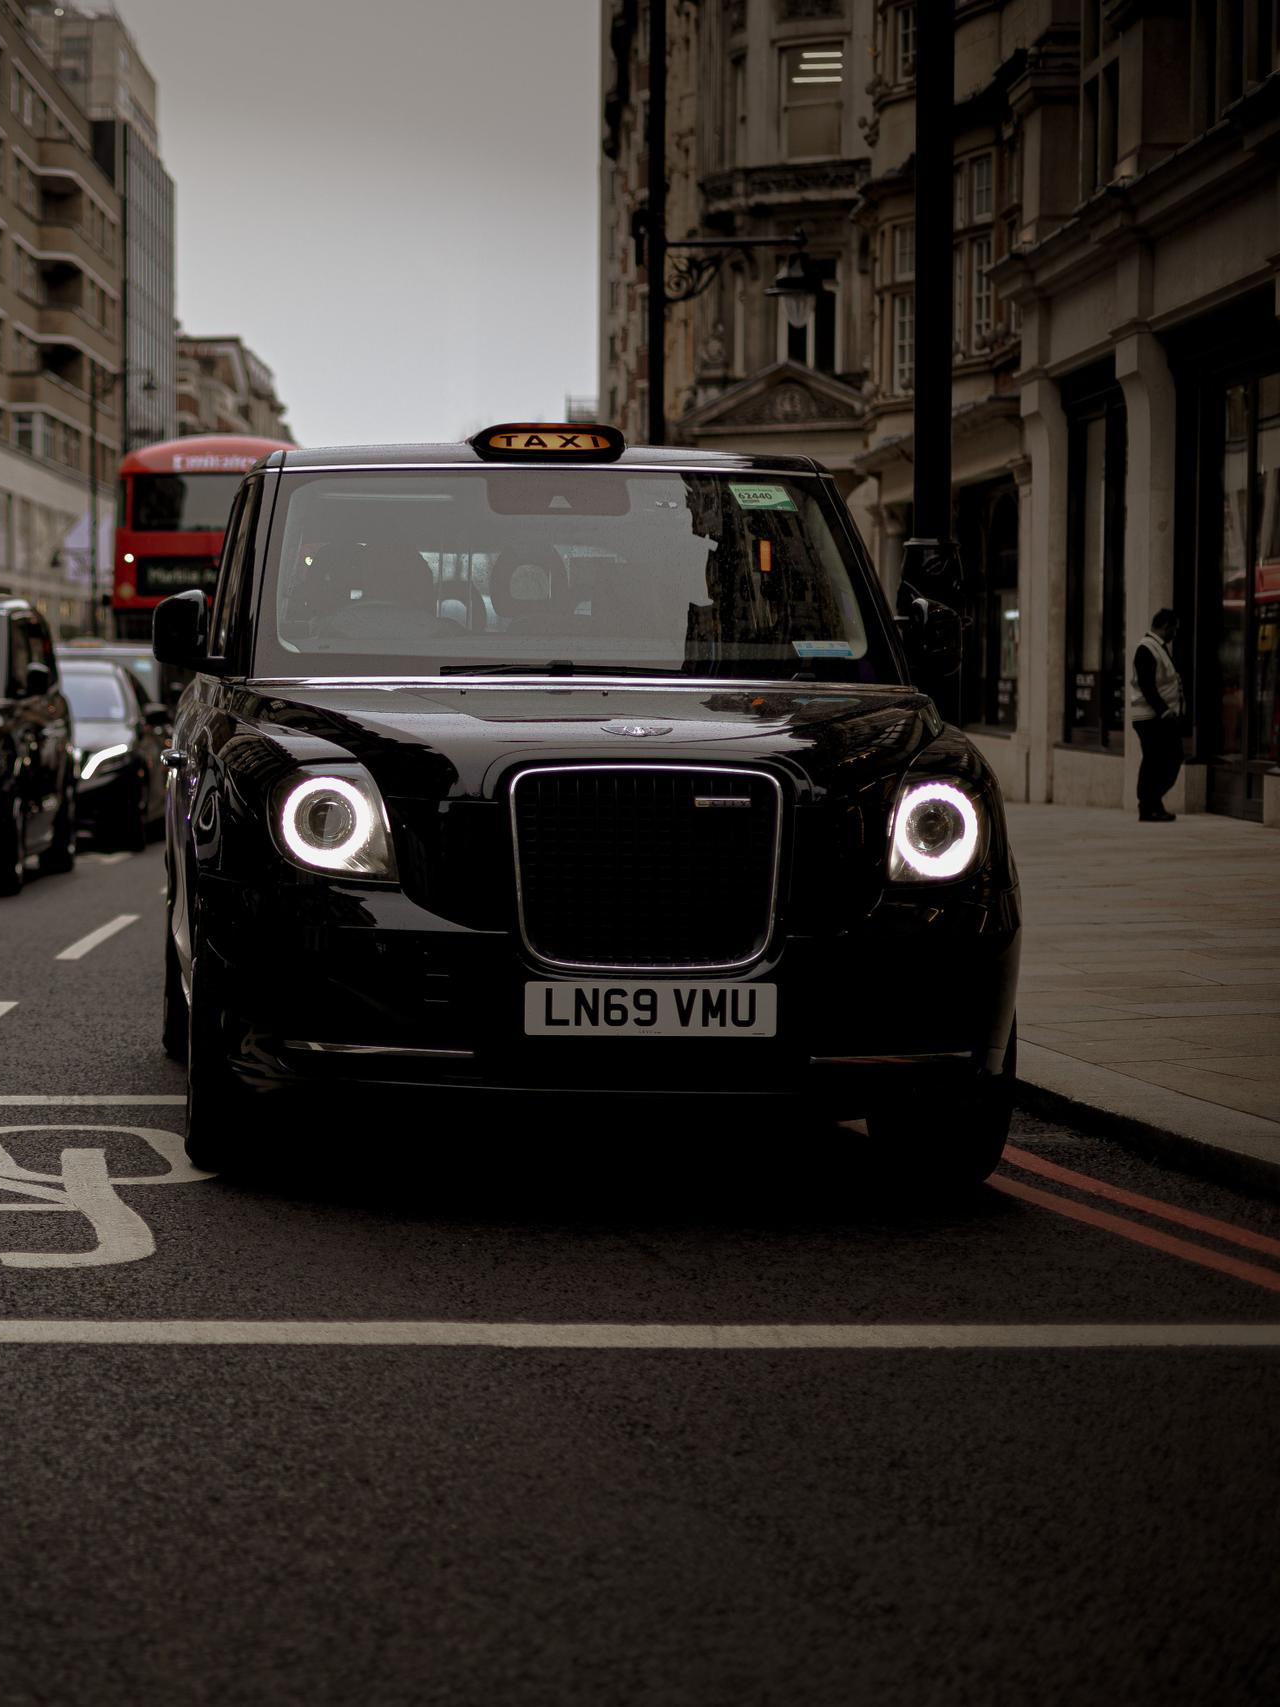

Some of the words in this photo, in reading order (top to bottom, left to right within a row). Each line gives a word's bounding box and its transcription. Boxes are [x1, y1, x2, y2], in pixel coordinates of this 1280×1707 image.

[500, 435, 600, 448] TAXI
[545, 988, 657, 1027] LN69
[673, 988, 756, 1028] VMU
